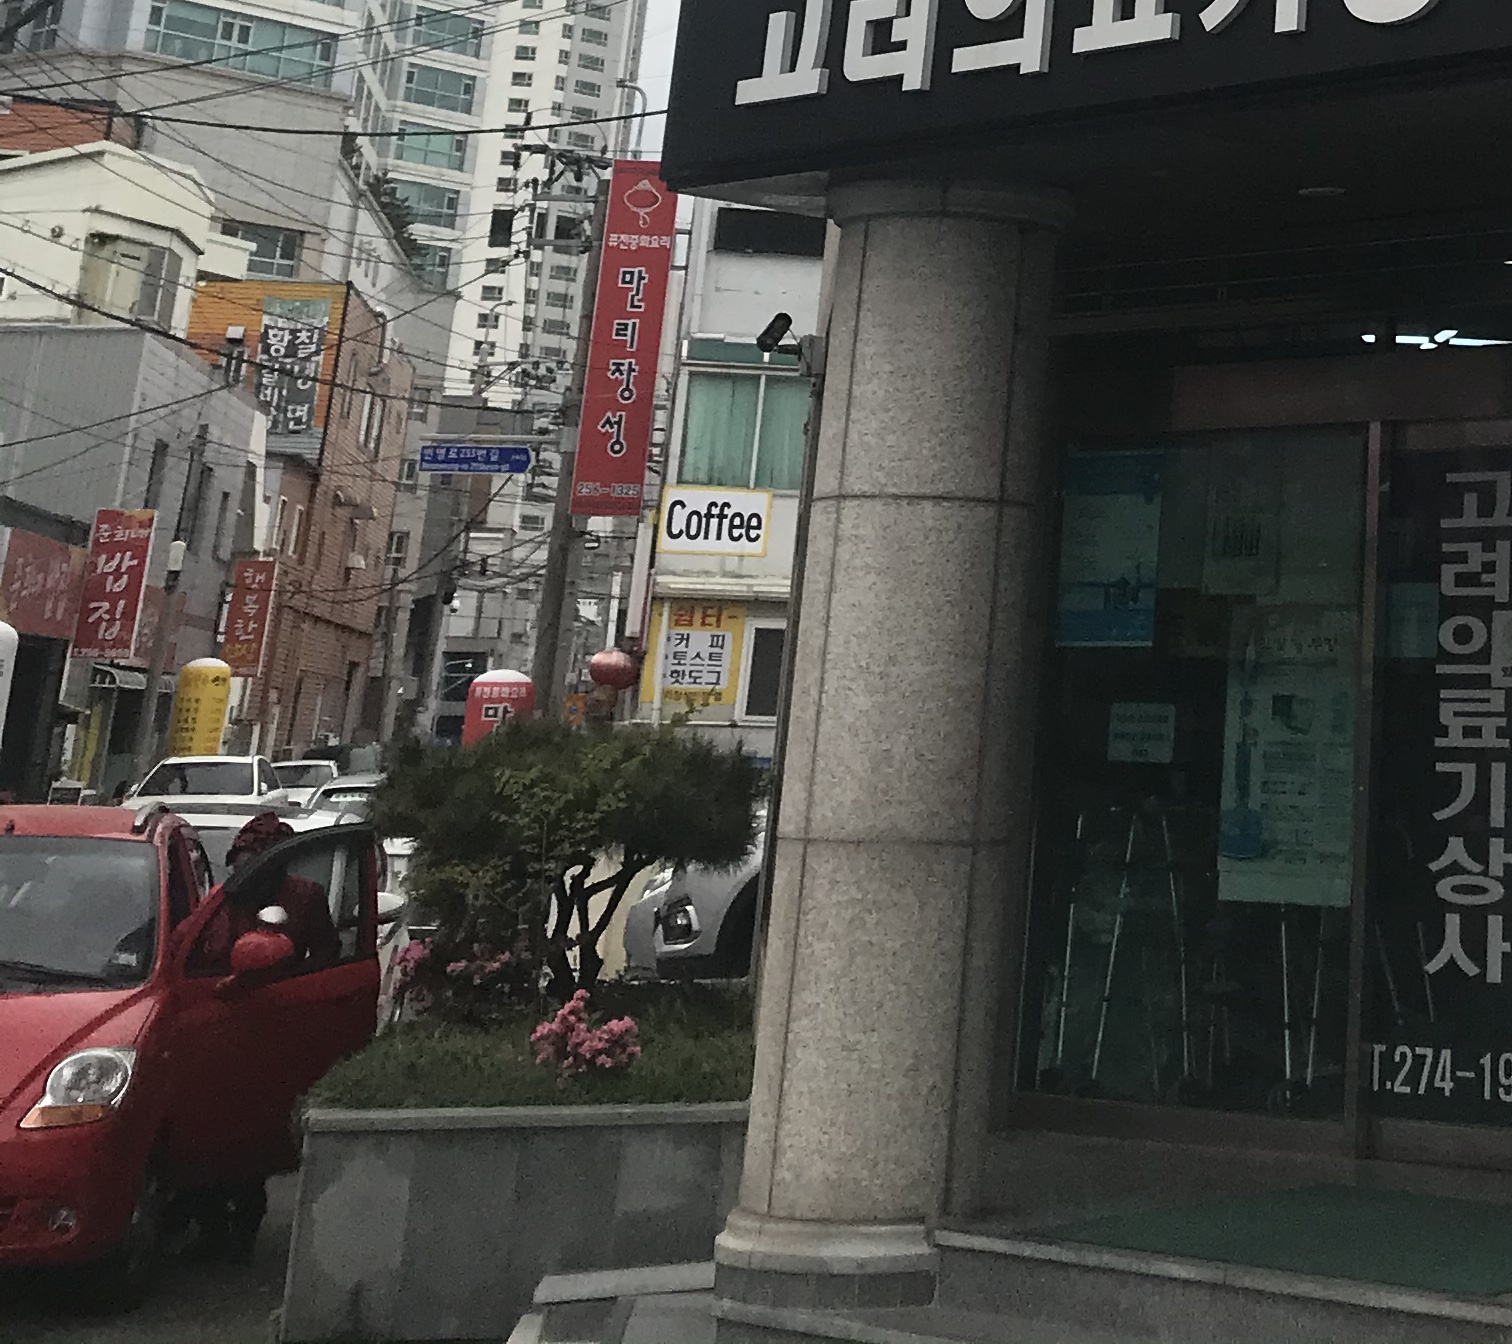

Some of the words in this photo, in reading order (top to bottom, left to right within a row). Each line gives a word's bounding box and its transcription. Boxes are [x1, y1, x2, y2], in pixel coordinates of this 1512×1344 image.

[607, 232, 672, 250] 퓨전중화요리
[597, 266, 649, 458] 만리장성
[666, 499, 763, 543] Coffee
[87, 550, 139, 641] 밥집
[670, 650, 724, 668] 토스트
[668, 669, 722, 686] 핫도그
